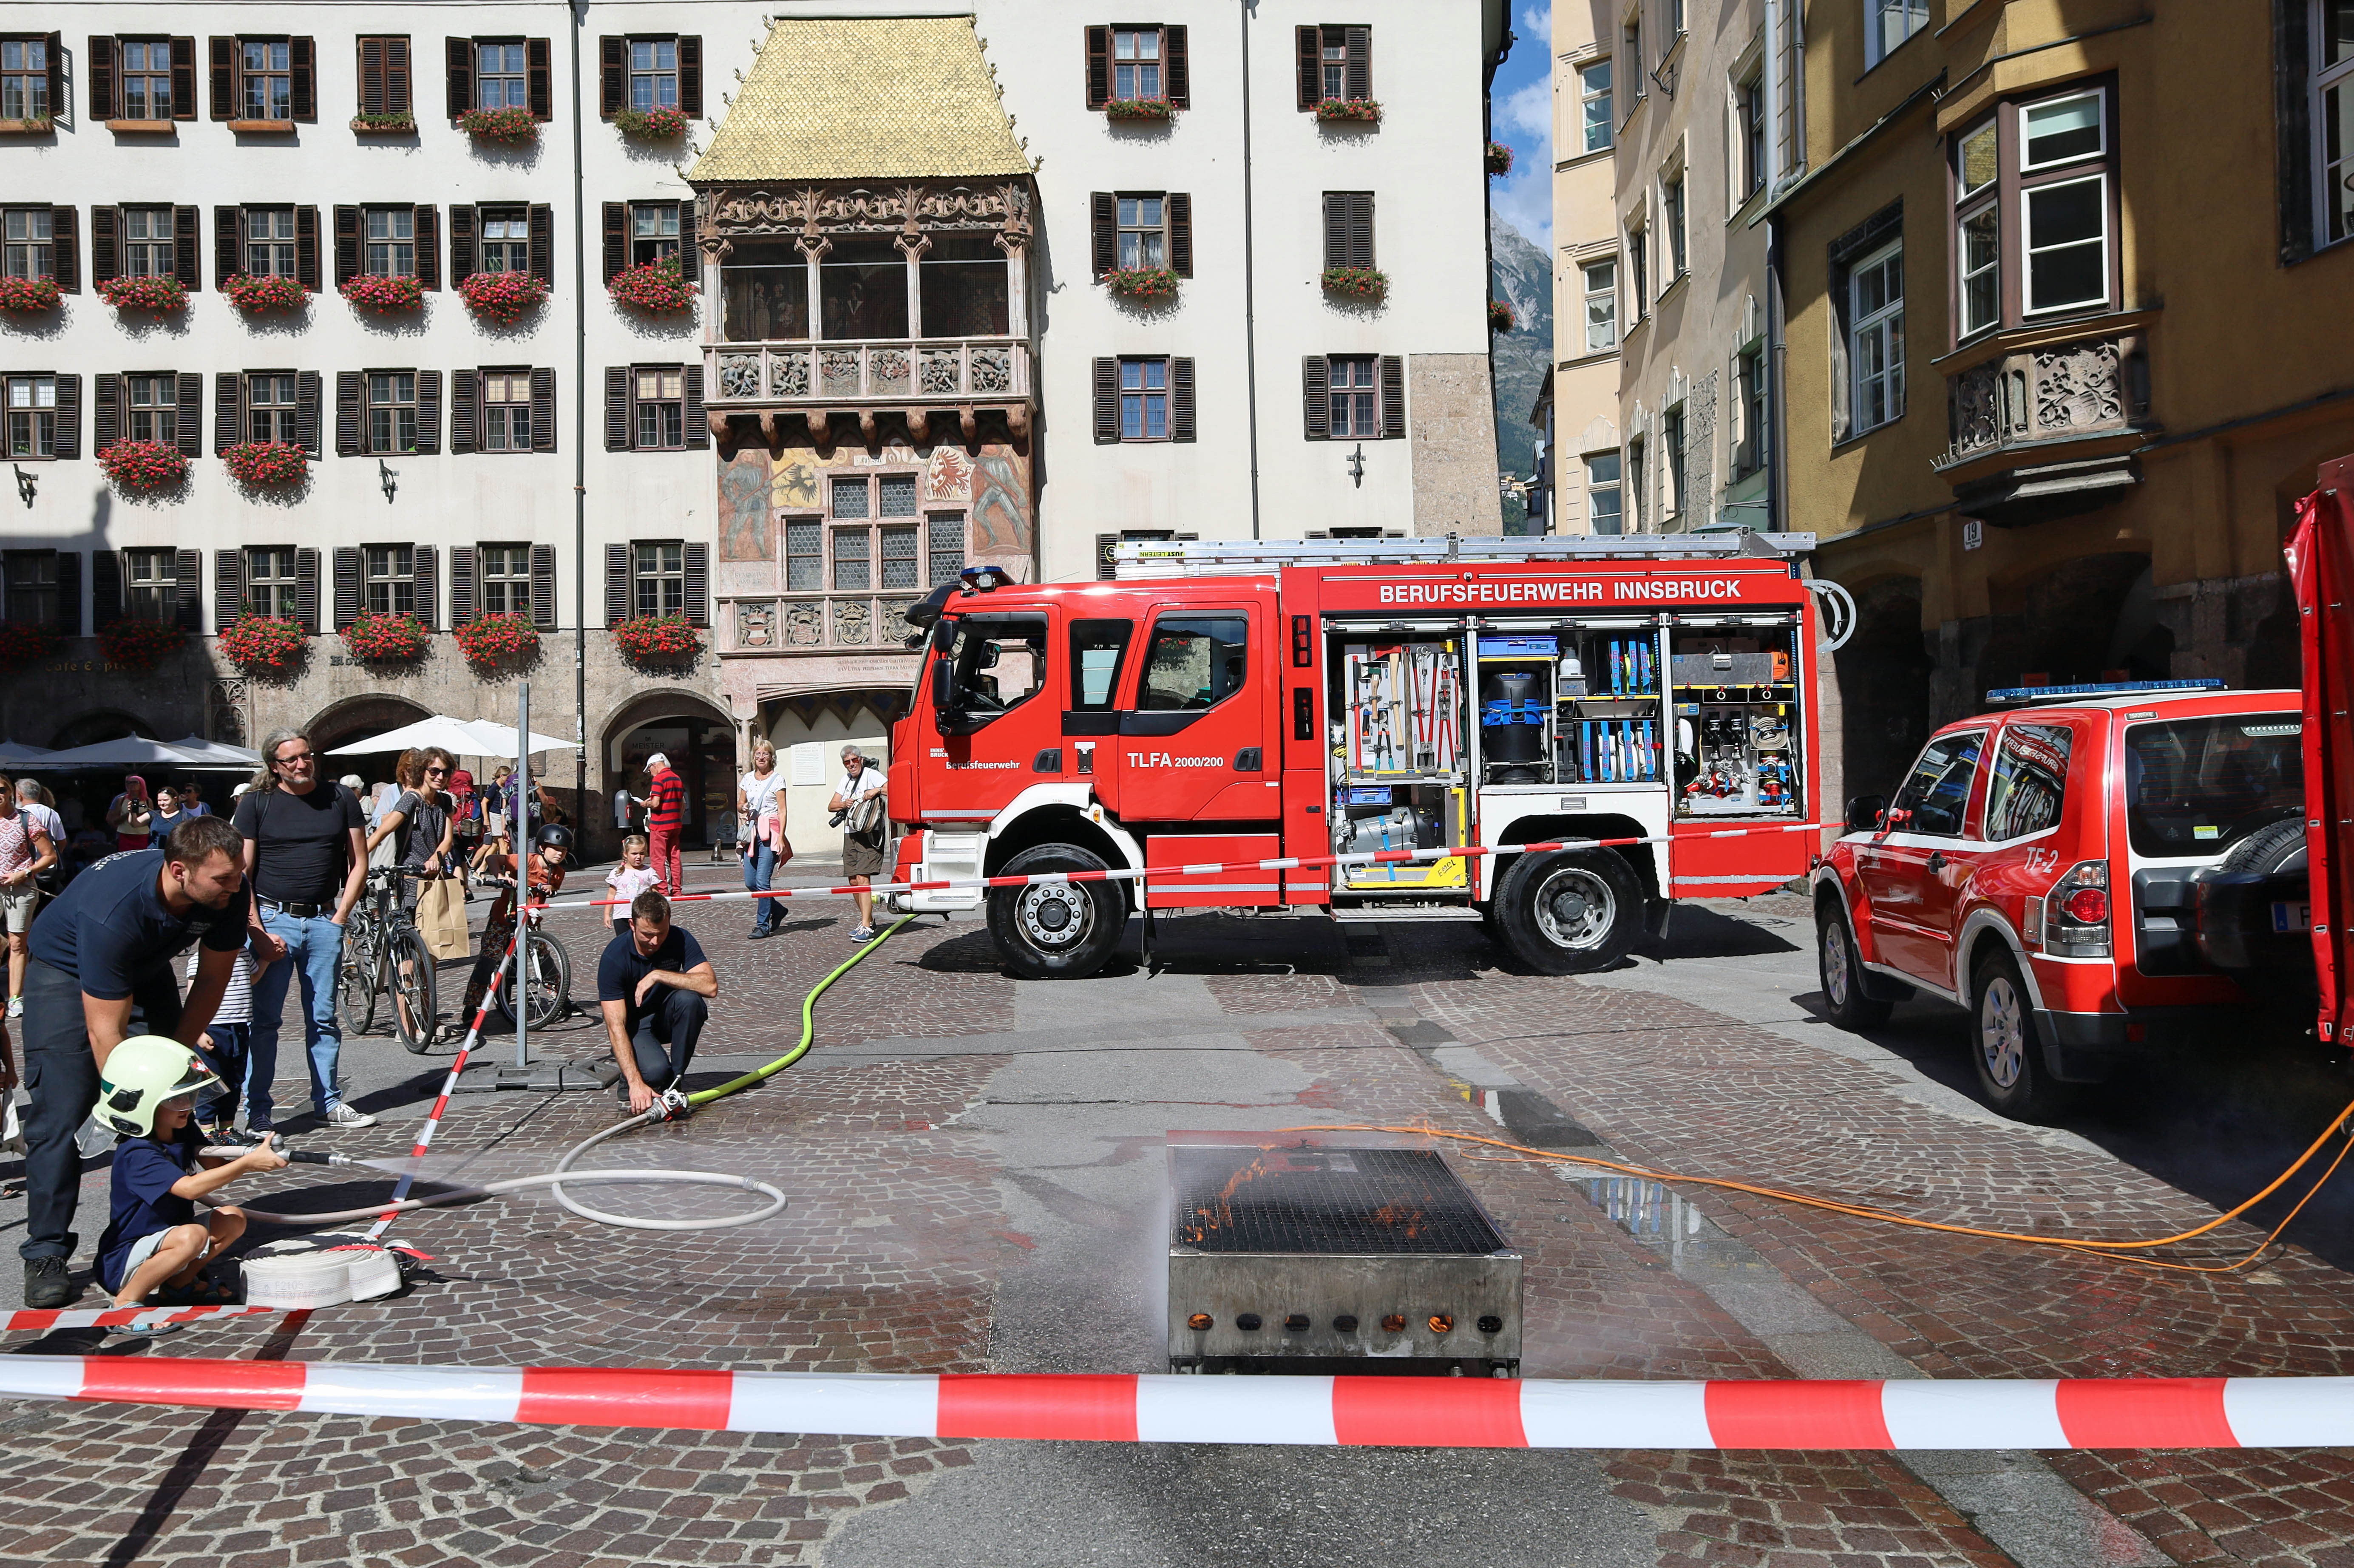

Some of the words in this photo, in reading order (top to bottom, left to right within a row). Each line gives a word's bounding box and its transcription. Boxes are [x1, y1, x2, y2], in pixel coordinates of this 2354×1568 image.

[1968, 522, 1977, 541] 19
[1380, 582, 1602, 603] BERUFSFEUERWEHR
[1614, 580, 1742, 599] INNSBRUCK
[946, 760, 1020, 769] Berufsfeuerwehr
[1127, 752, 1172, 768] TLFA
[1174, 757, 1223, 768] 2000/200
[1438, 859, 1457, 877] EMPL
[2023, 846, 2059, 873] TF-2
